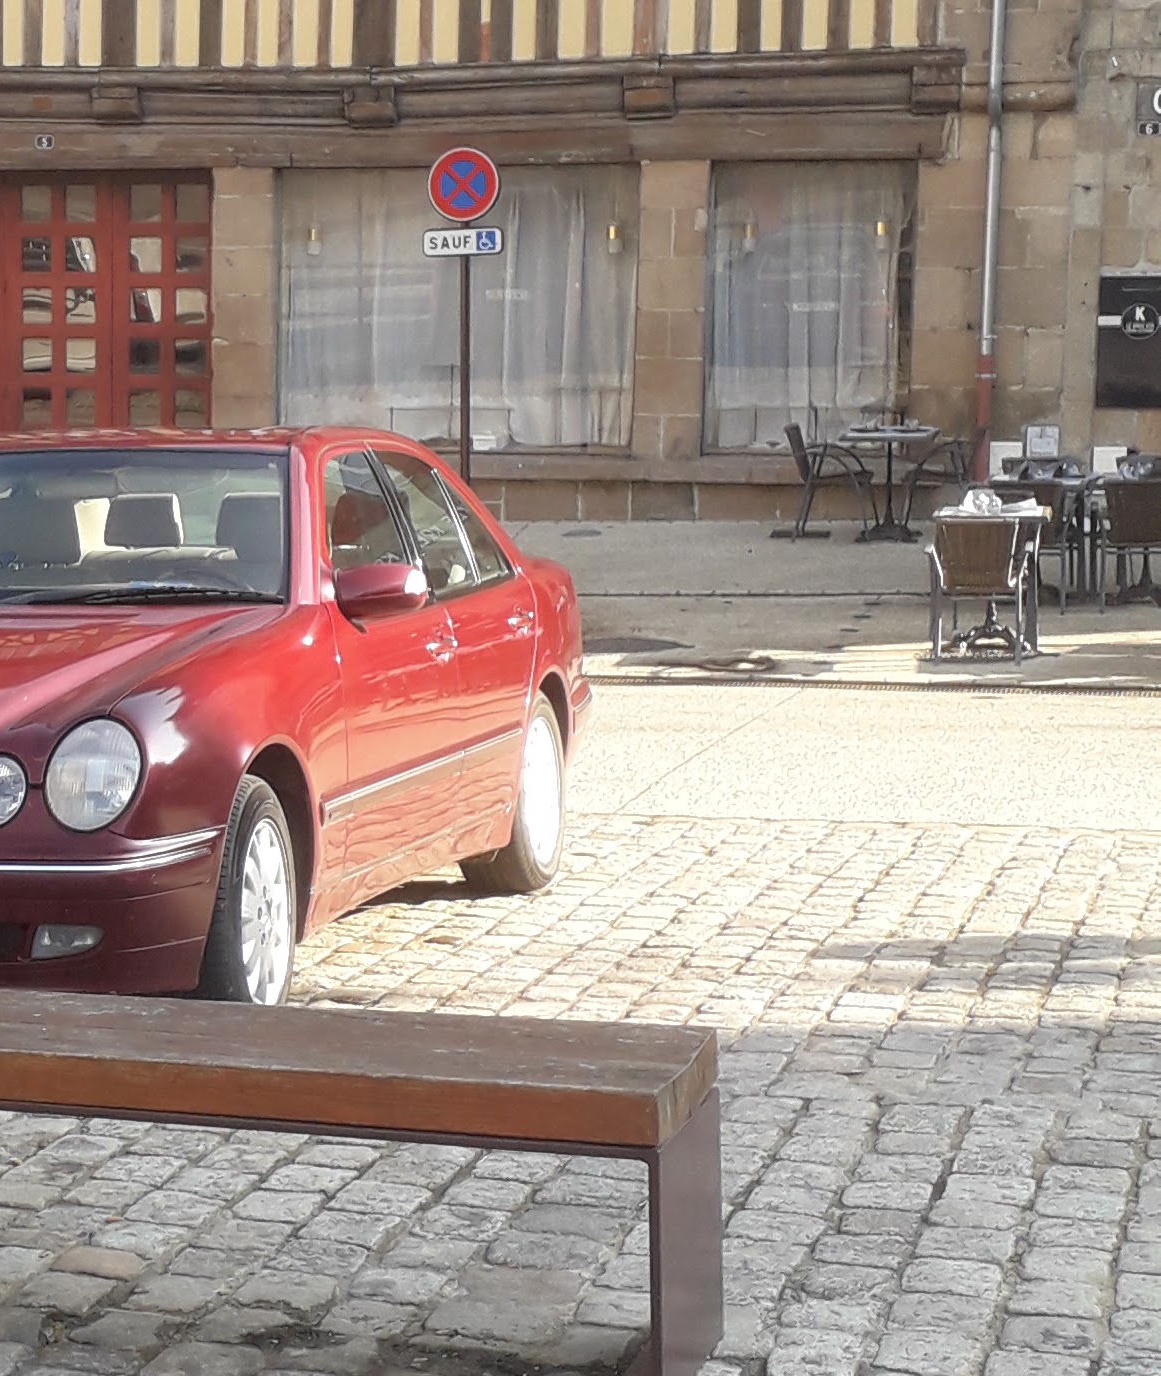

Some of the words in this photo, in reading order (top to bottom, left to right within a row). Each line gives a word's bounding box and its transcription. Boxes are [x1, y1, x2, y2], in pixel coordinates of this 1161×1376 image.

[1145, 123, 1154, 135] 6
[429, 235, 471, 250] SAUF
[1135, 305, 1146, 321] K
